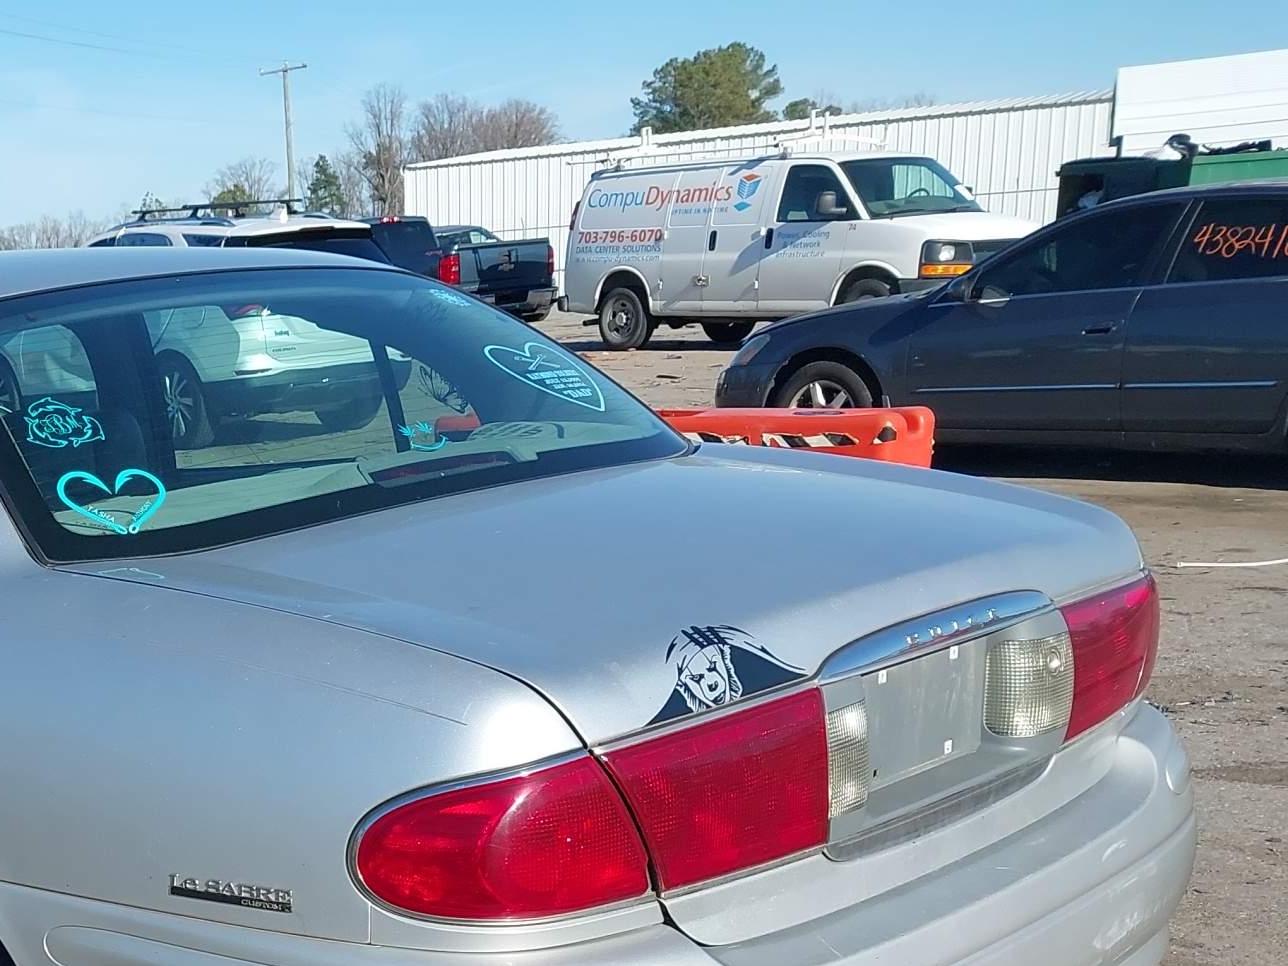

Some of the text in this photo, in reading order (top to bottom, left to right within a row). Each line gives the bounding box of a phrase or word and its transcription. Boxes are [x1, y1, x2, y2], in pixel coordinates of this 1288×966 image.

[588, 181, 733, 213] CompuDynamics
[578, 228, 663, 244] 703-796-6070
[575, 244, 661, 254] DATA CENTER SOLUTIONS
[87, 504, 116, 523] TASHA
